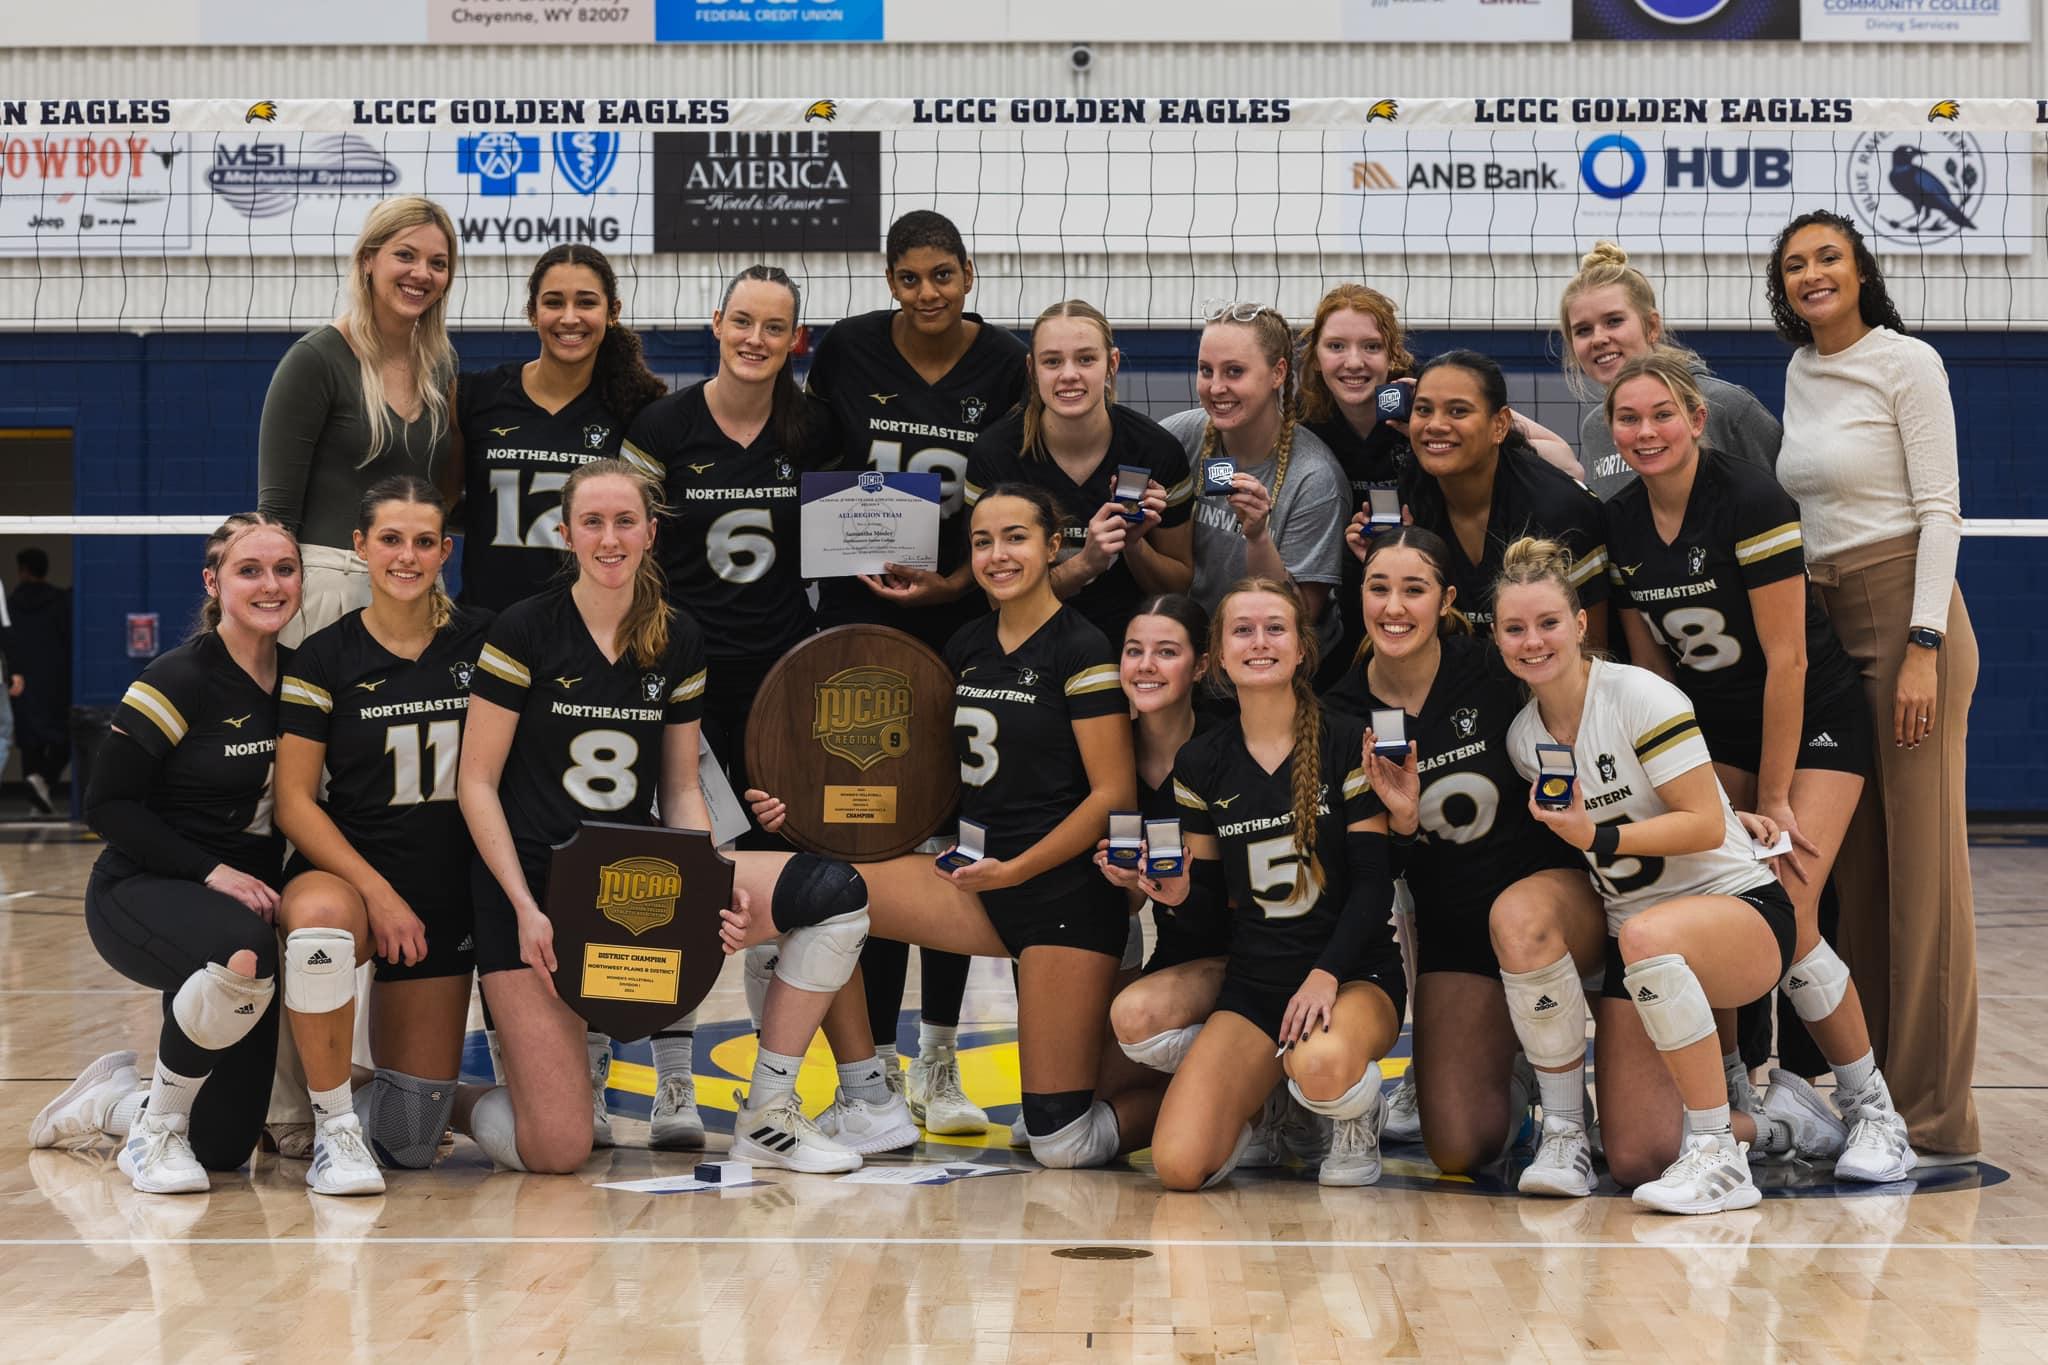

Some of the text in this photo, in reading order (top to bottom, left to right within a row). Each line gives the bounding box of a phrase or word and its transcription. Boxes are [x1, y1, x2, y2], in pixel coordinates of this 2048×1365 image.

[696, 10, 844, 22] FEDERAL CREDIT UNION
[1823, 0, 2001, 10] COMMUNITY COLLEGE
[451, 8, 629, 27] Cheyenne, WY 82007
[1865, 18, 1960, 32] Dining Services
[40, 100, 171, 125] EAGLES
[354, 100, 730, 124] LCCC GOLDEN EAGLES
[913, 99, 1291, 124] LCCC GOLDEN EAGLES
[1474, 99, 1853, 123] LCCC GOLDEN EAGLES
[217, 144, 285, 166] MSI
[707, 131, 830, 158] LITTLE
[0, 137, 149, 179] OWBOY
[1665, 147, 1791, 188] HUB
[223, 170, 385, 186] Mechanical Systems
[685, 160, 849, 189] AMERICA
[1408, 162, 1476, 189] ANB
[705, 194, 755, 210] Hotel
[1856, 171, 1878, 214] BLUE
[27, 213, 64, 230] Jeep
[459, 217, 620, 243] WYOMING
[868, 417, 979, 443] NORTHEASTER
[486, 448, 607, 465] NORTHEASTER
[685, 486, 798, 500] NORTHEASTERN
[882, 511, 902, 519] TEAM
[706, 508, 776, 584] 6
[551, 701, 663, 721] NORTHEASTERN
[817, 686, 910, 732] NJCAA
[835, 732, 901, 748] REGION 9
[954, 705, 999, 787] 3
[1809, 740, 1838, 748] adidas
[385, 719, 461, 806] 11
[562, 729, 639, 812] 8
[601, 869, 680, 904] NJCAA
[1246, 834, 1321, 920] 5
[588, 963, 623, 971] NORTHWEST
[598, 952, 666, 964] DISTRICT CHAMPION
